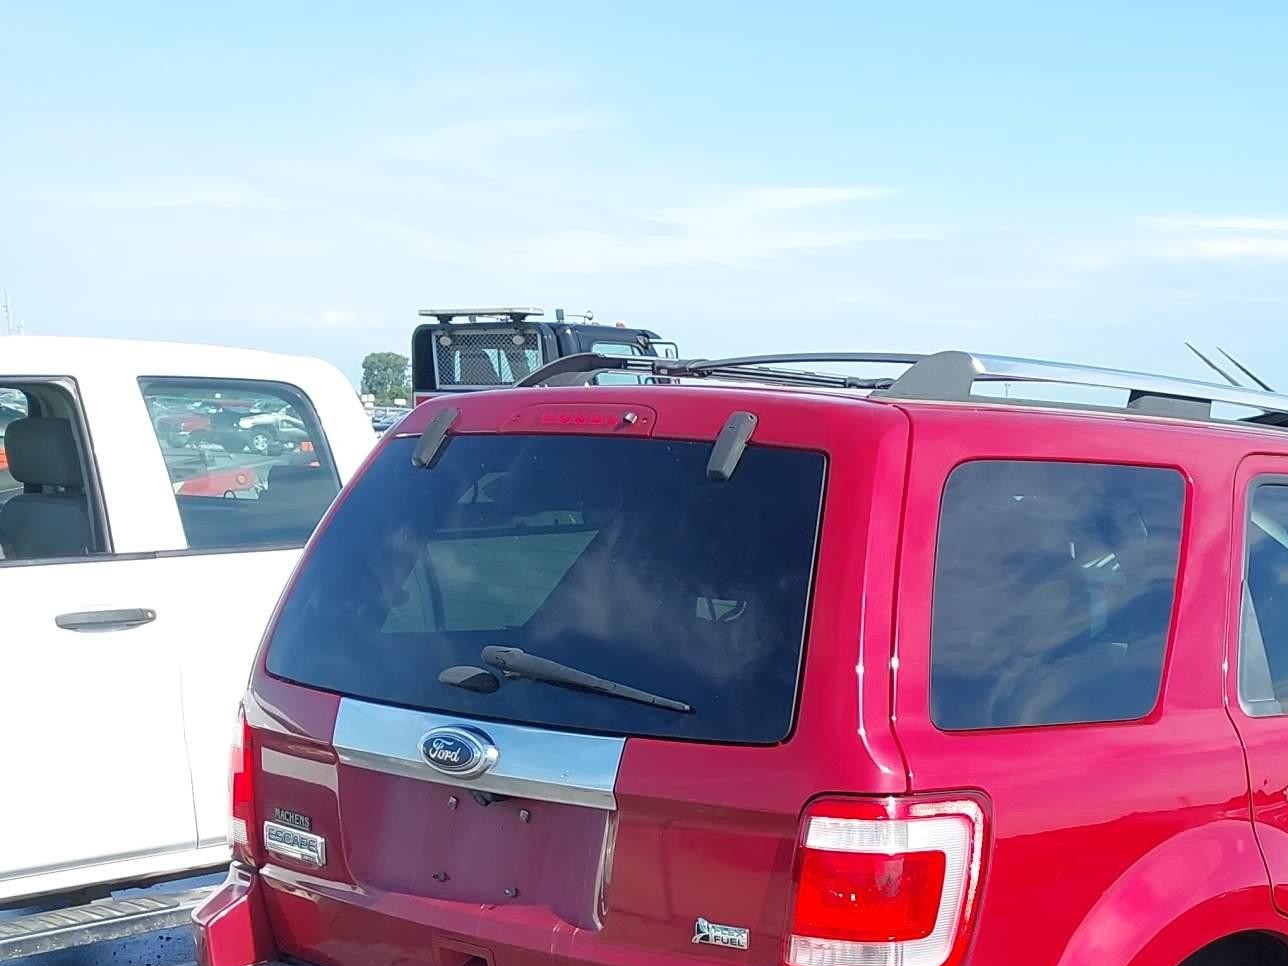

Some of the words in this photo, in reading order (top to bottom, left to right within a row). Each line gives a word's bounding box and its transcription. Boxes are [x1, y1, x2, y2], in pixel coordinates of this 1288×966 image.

[428, 738, 462, 763] Ford
[274, 807, 311, 828] MACHENS
[268, 828, 317, 852] ESCAPE
[713, 935, 745, 947] FUEL
